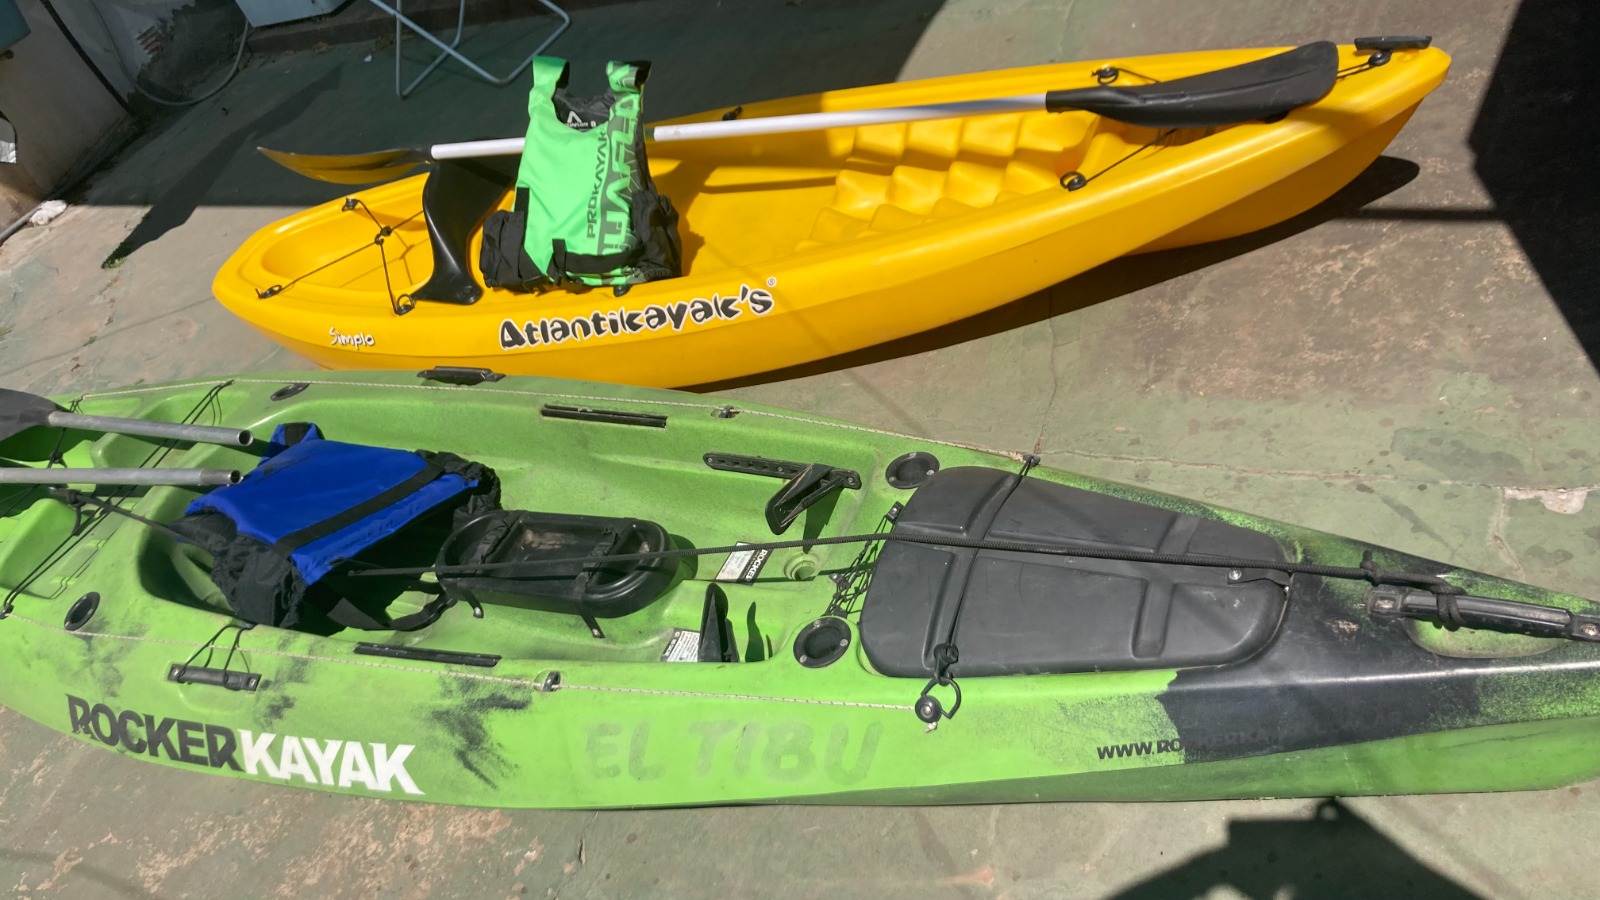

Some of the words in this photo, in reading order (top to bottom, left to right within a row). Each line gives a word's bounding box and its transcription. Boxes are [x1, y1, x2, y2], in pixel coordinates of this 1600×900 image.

[499, 284, 774, 351] Atlantikayak's
[585, 721, 666, 782] EL
[688, 719, 884, 786] TIBU
